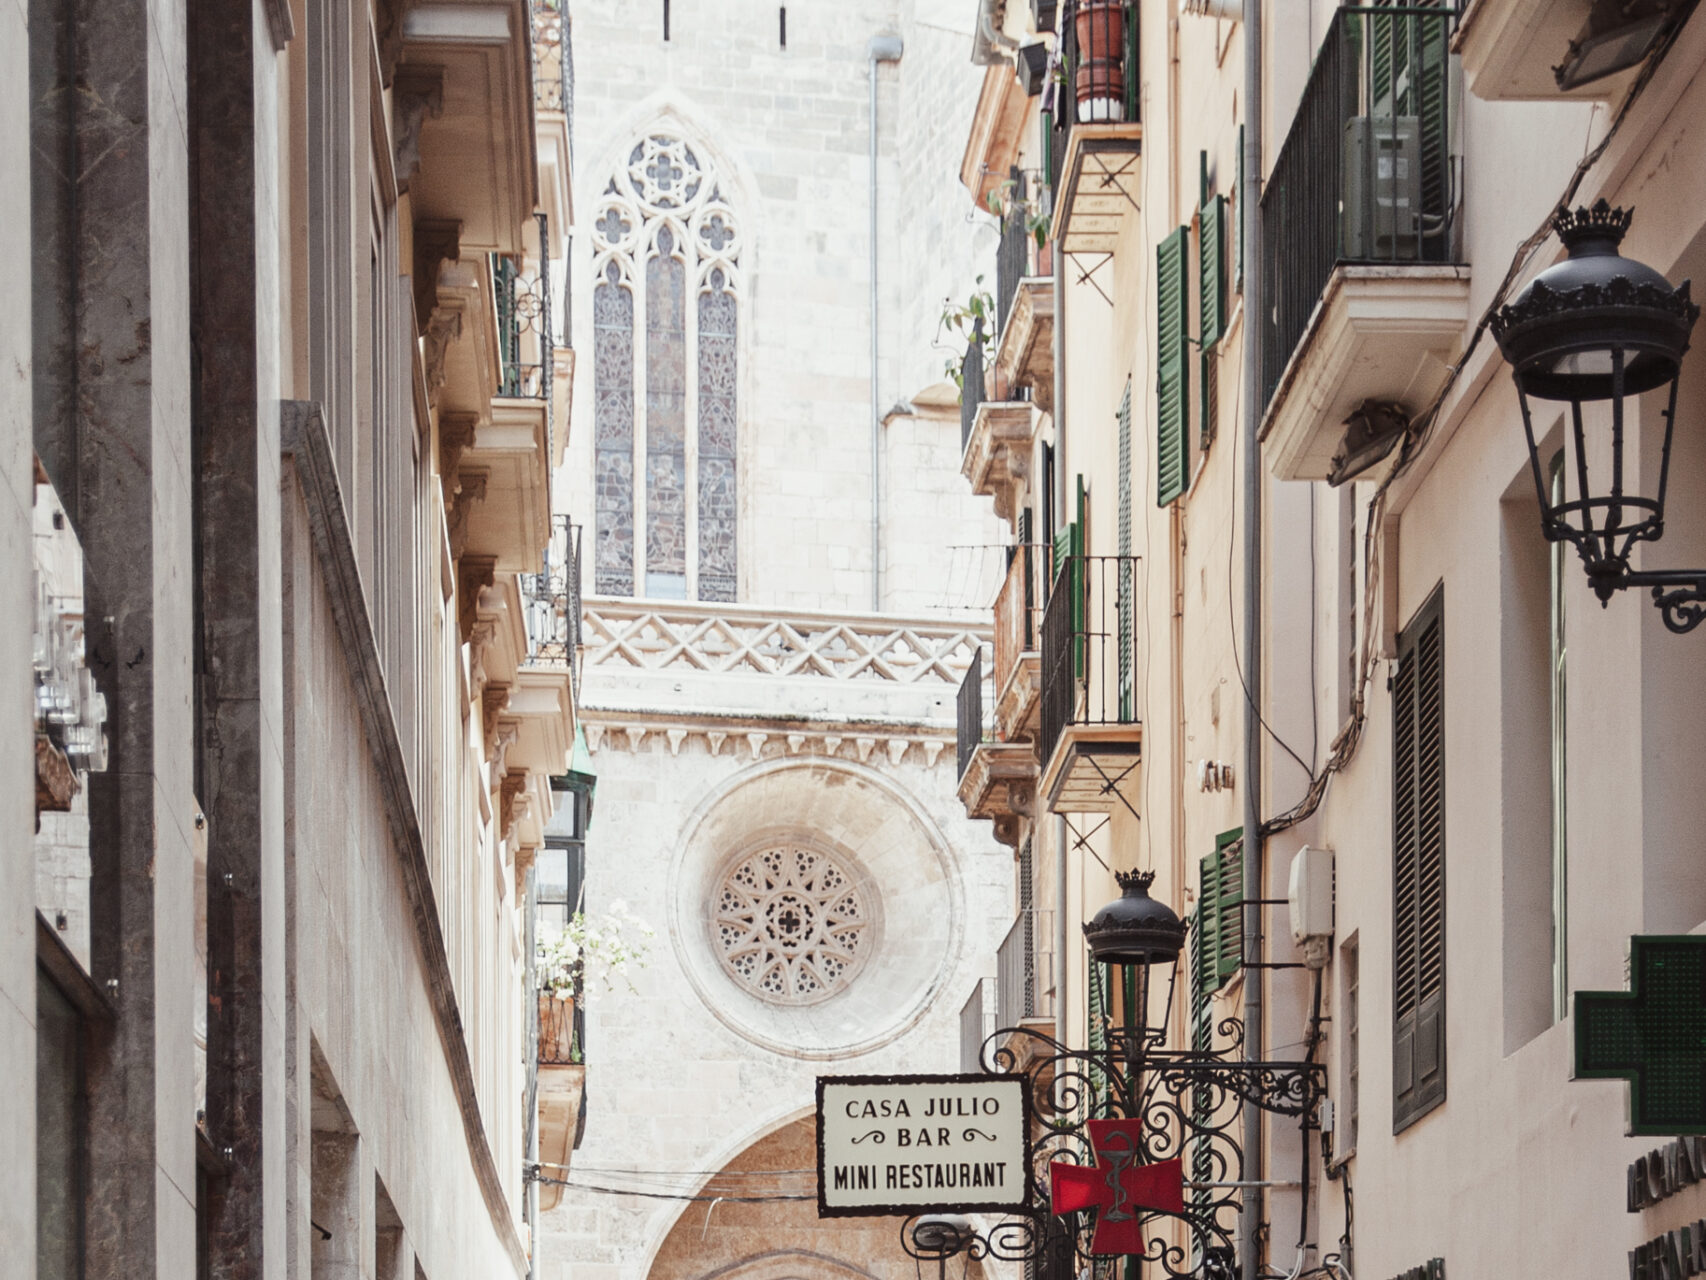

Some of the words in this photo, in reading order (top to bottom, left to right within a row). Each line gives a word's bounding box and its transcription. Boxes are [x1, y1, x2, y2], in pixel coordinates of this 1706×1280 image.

[845, 1099, 911, 1118] CASA
[924, 1097, 1000, 1117] JULIO
[897, 1127, 951, 1147] BAR
[834, 1165, 877, 1190] MINI
[886, 1162, 1007, 1190] RESTAURANT
